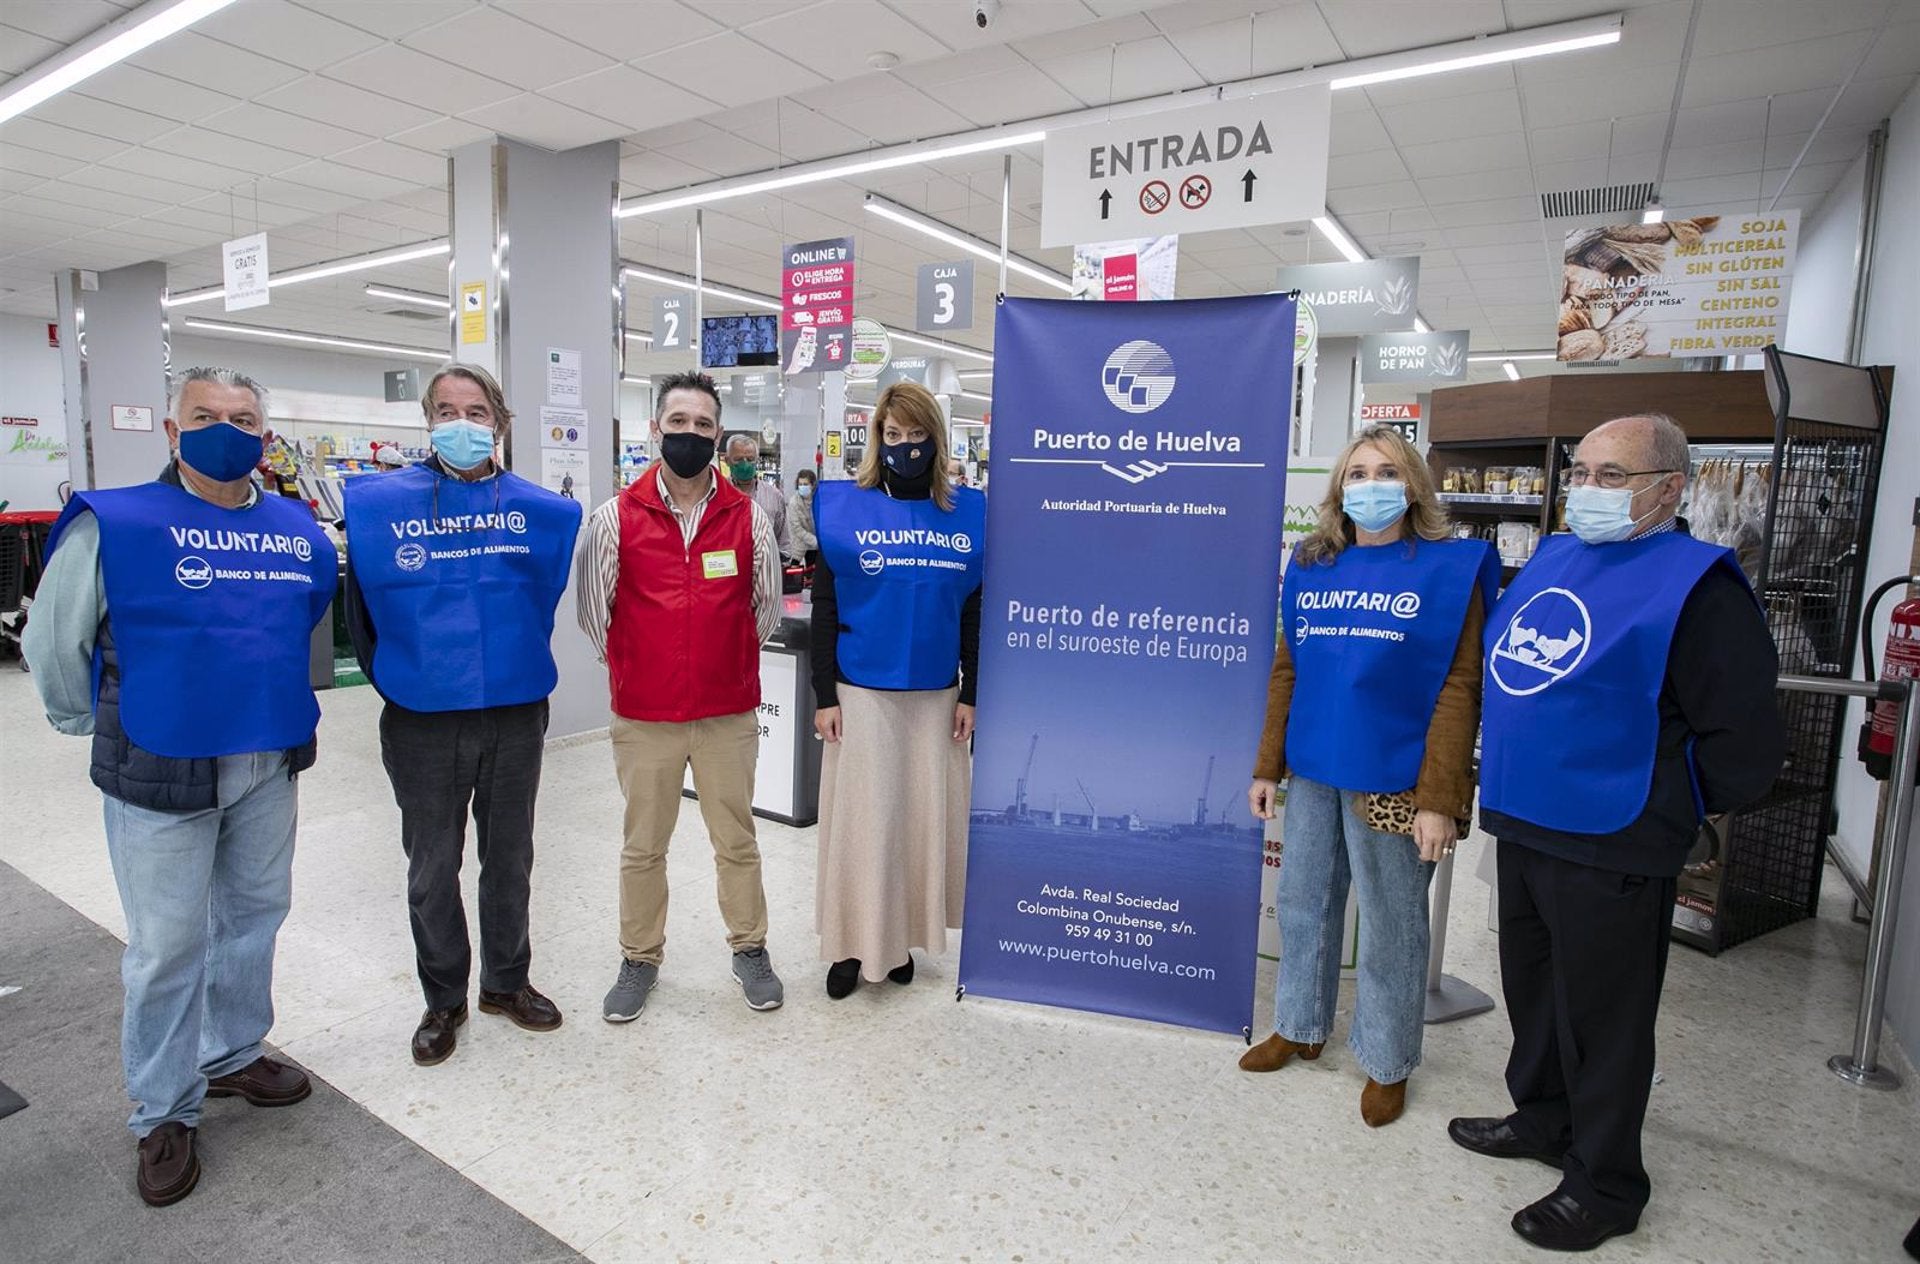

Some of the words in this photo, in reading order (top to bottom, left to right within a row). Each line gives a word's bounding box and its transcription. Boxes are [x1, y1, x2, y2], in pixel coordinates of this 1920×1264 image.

[1090, 120, 1273, 179] ENTRADA
[1741, 220, 1787, 234] SOJA
[1674, 237, 1786, 257] MULTICEREAL
[791, 248, 835, 265] ONLINE
[933, 268, 957, 278] CAJA
[1686, 262, 1713, 275] SIN
[1719, 256, 1784, 272] GLÚTEN
[811, 274, 844, 284] ENTREGA
[1717, 279, 1744, 292] SIN
[1750, 276, 1780, 290] SAL
[809, 290, 842, 301] FRESCOS
[933, 283, 955, 324] 3
[1303, 287, 1375, 305] NADERÍA
[1700, 296, 1779, 311] CENTENO
[663, 300, 680, 309] CAJA
[663, 312, 679, 347] 2
[1696, 315, 1776, 330] INTEGRAL
[1670, 337, 1716, 350] FIBRA
[1722, 334, 1775, 348] VERDE
[1379, 345, 1427, 358] HORNO
[891, 359, 926, 369] VERDURAS
[1380, 359, 1396, 370] DE
[1399, 357, 1425, 370] PAN
[1034, 429, 1111, 450] Puerto
[1118, 430, 1148, 450] de
[1156, 431, 1241, 452] Huelva
[1041, 499, 1101, 511] Autoridad
[1104, 500, 1163, 513] Portuaria
[1165, 502, 1180, 515] de
[1183, 503, 1227, 515] Huelva
[391, 511, 527, 539] VOLUNTARI@
[170, 526, 312, 562] VOLUNTARI@
[855, 529, 972, 553] VOLUNTARI@
[431, 549, 469, 559] BANCOS
[471, 548, 482, 556] DE
[484, 545, 531, 555] ALIMENTOS
[886, 557, 916, 566] BANCO
[917, 558, 928, 567] DE
[929, 559, 967, 571] ALIMENTOS
[215, 569, 252, 580] BANCO
[254, 570, 267, 581] DE
[269, 571, 313, 583] ALIMENTOS
[1008, 600, 1082, 625] Puerto
[1092, 604, 1119, 628] de
[1129, 607, 1249, 635] referencia
[1310, 626, 1337, 636] BANCO
[1339, 627, 1348, 636] DE
[1350, 627, 1405, 642] ALIMENTOS
[1007, 631, 1031, 648] en
[1037, 627, 1052, 649] el
[1059, 632, 1140, 656] suroeste
[1146, 634, 1171, 658] de
[1177, 636, 1247, 667] Europa
[1041, 884, 1078, 900] Avda.
[1083, 888, 1112, 904] Real
[1116, 892, 1180, 912] Sociedad
[1017, 900, 1089, 921] Colombina
[1093, 909, 1167, 933] Onubense,
[1171, 920, 1197, 936] s/n.
[1065, 924, 1090, 938] 959
[1094, 927, 1111, 941] 49
[1115, 930, 1131, 944] 31
[1135, 932, 1153, 947] 00
[999, 939, 1215, 980] www.puertohuelva.com
